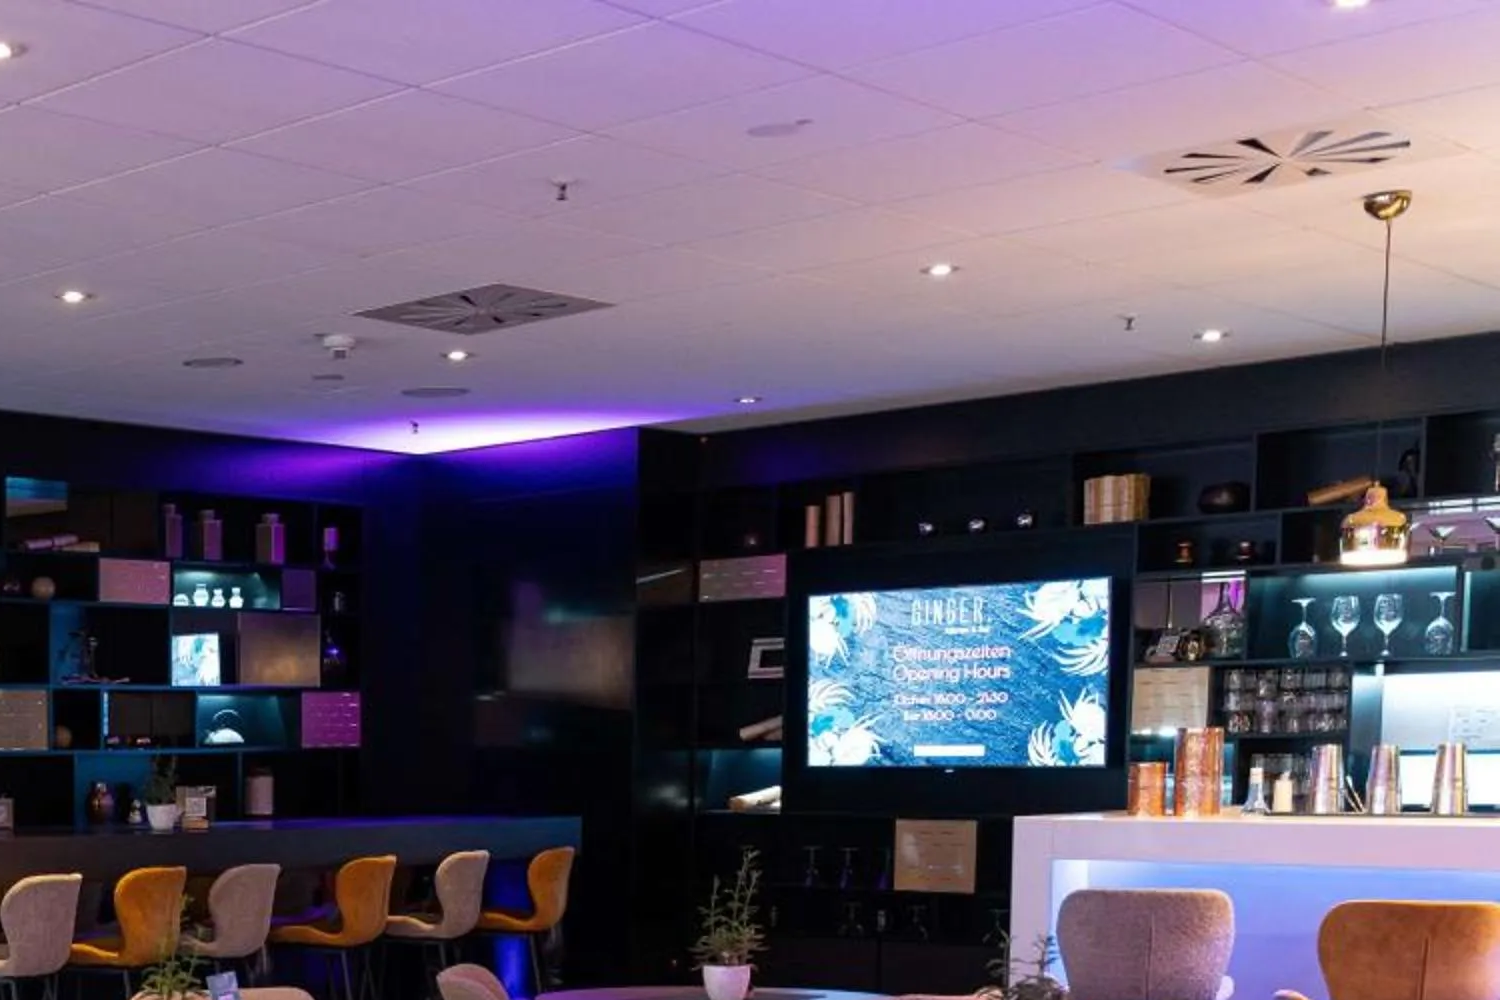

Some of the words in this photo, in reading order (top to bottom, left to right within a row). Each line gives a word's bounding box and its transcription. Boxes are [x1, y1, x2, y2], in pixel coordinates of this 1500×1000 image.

[893, 643, 1011, 664] Öffnungszeiten
[893, 664, 961, 684] Opening
[963, 662, 1011, 679] Hours
